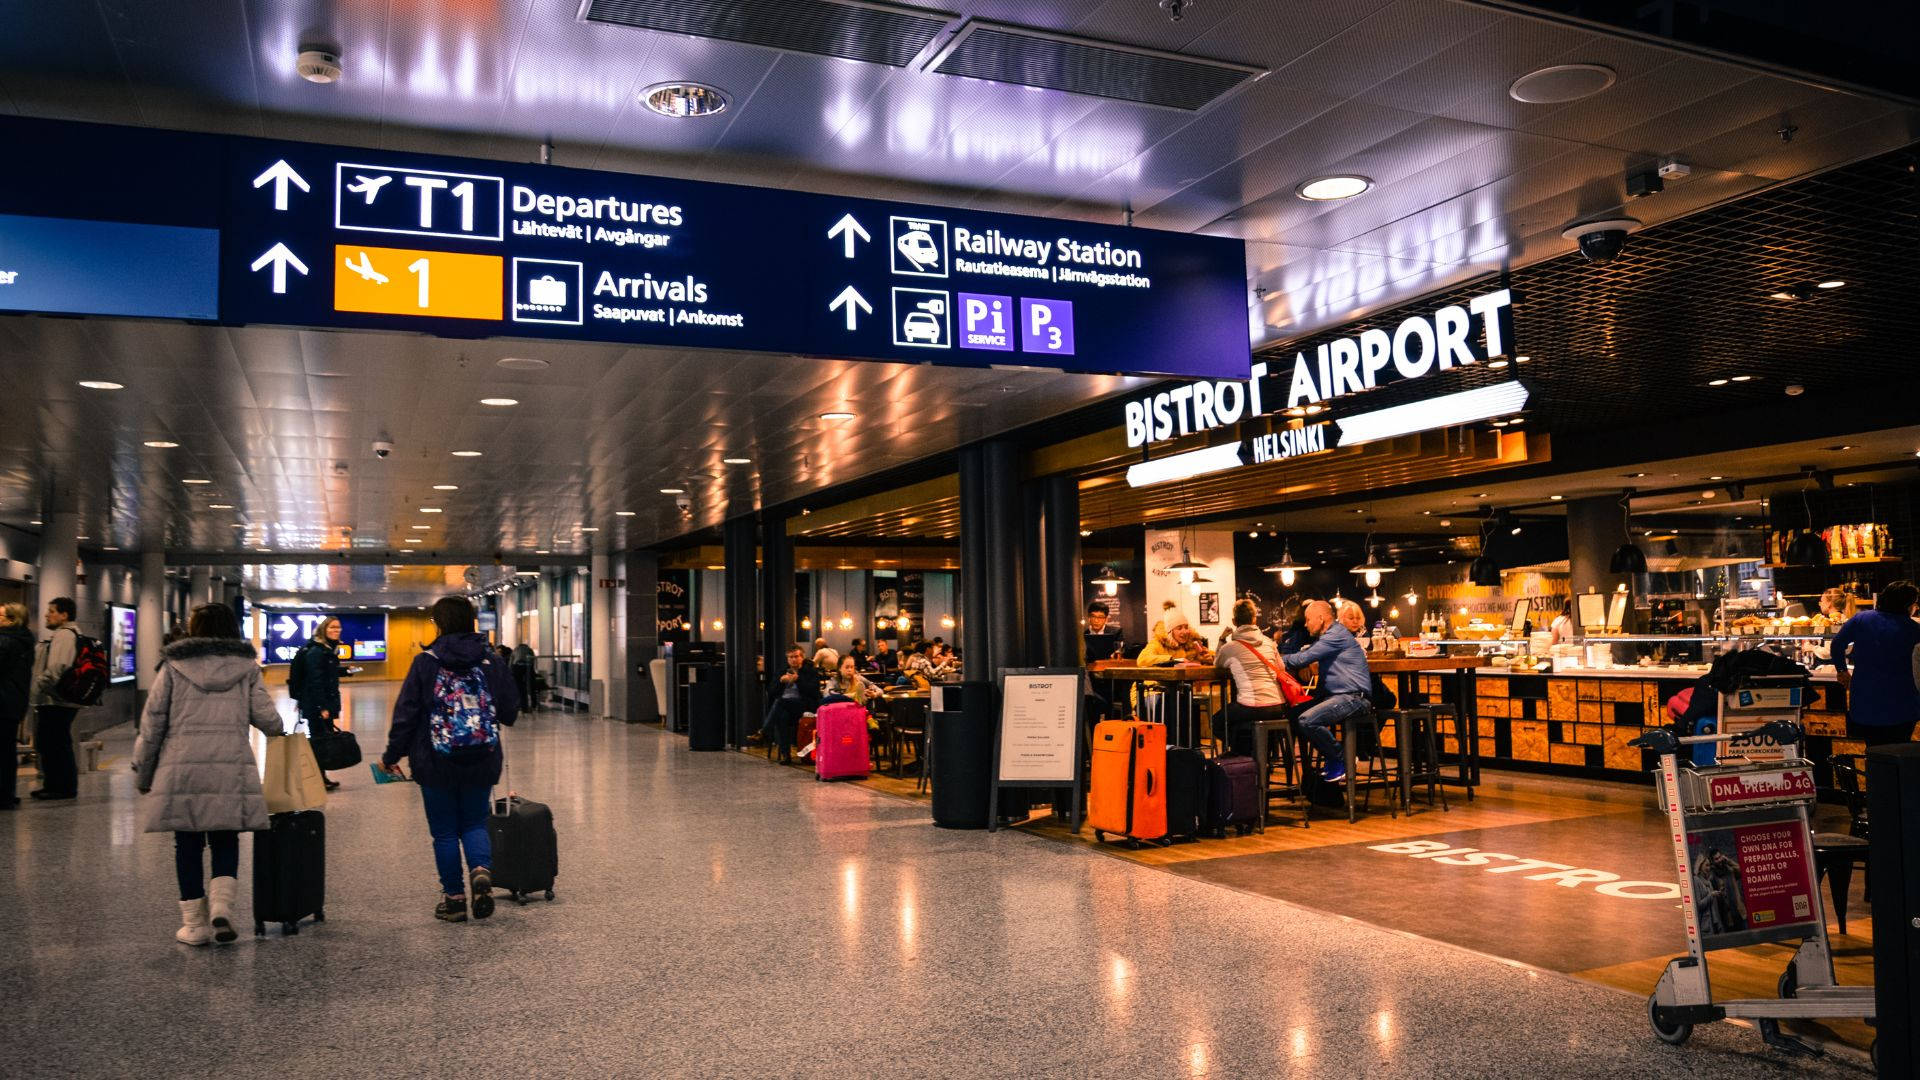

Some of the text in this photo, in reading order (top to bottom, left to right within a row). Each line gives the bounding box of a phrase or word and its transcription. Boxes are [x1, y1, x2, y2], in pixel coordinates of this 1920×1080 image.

[405, 176, 474, 231] T1
[512, 185, 683, 226] Departures
[512, 219, 583, 240] Lähtevät
[595, 226, 670, 248] Avgångar
[954, 228, 1142, 268] Railway Station
[408, 258, 429, 308] 1
[593, 270, 708, 303] Arrivals
[955, 258, 1049, 280] Rautatieasema
[1059, 267, 1150, 288] Järnvägsstation
[593, 304, 665, 322] Saapuvat
[676, 309, 744, 327] Ankomst
[966, 298, 1006, 334] Pi
[968, 334, 1006, 346] SERVICE
[1125, 289, 1511, 448] BISTROT AIRPORT
[1253, 423, 1324, 463] HELSINKI
[1715, 777, 1811, 797] DNA PREPAID 4G
[1740, 830, 1792, 843] CHOOSE YOUR
[1742, 840, 1793, 853] OWN DNA FOR
[1366, 840, 1682, 900] BISTRO
[1743, 850, 1800, 863] PREPAID CALLS,
[1745, 861, 1788, 873] 4G DATA OR
[1746, 873, 1783, 884] ROAMING
